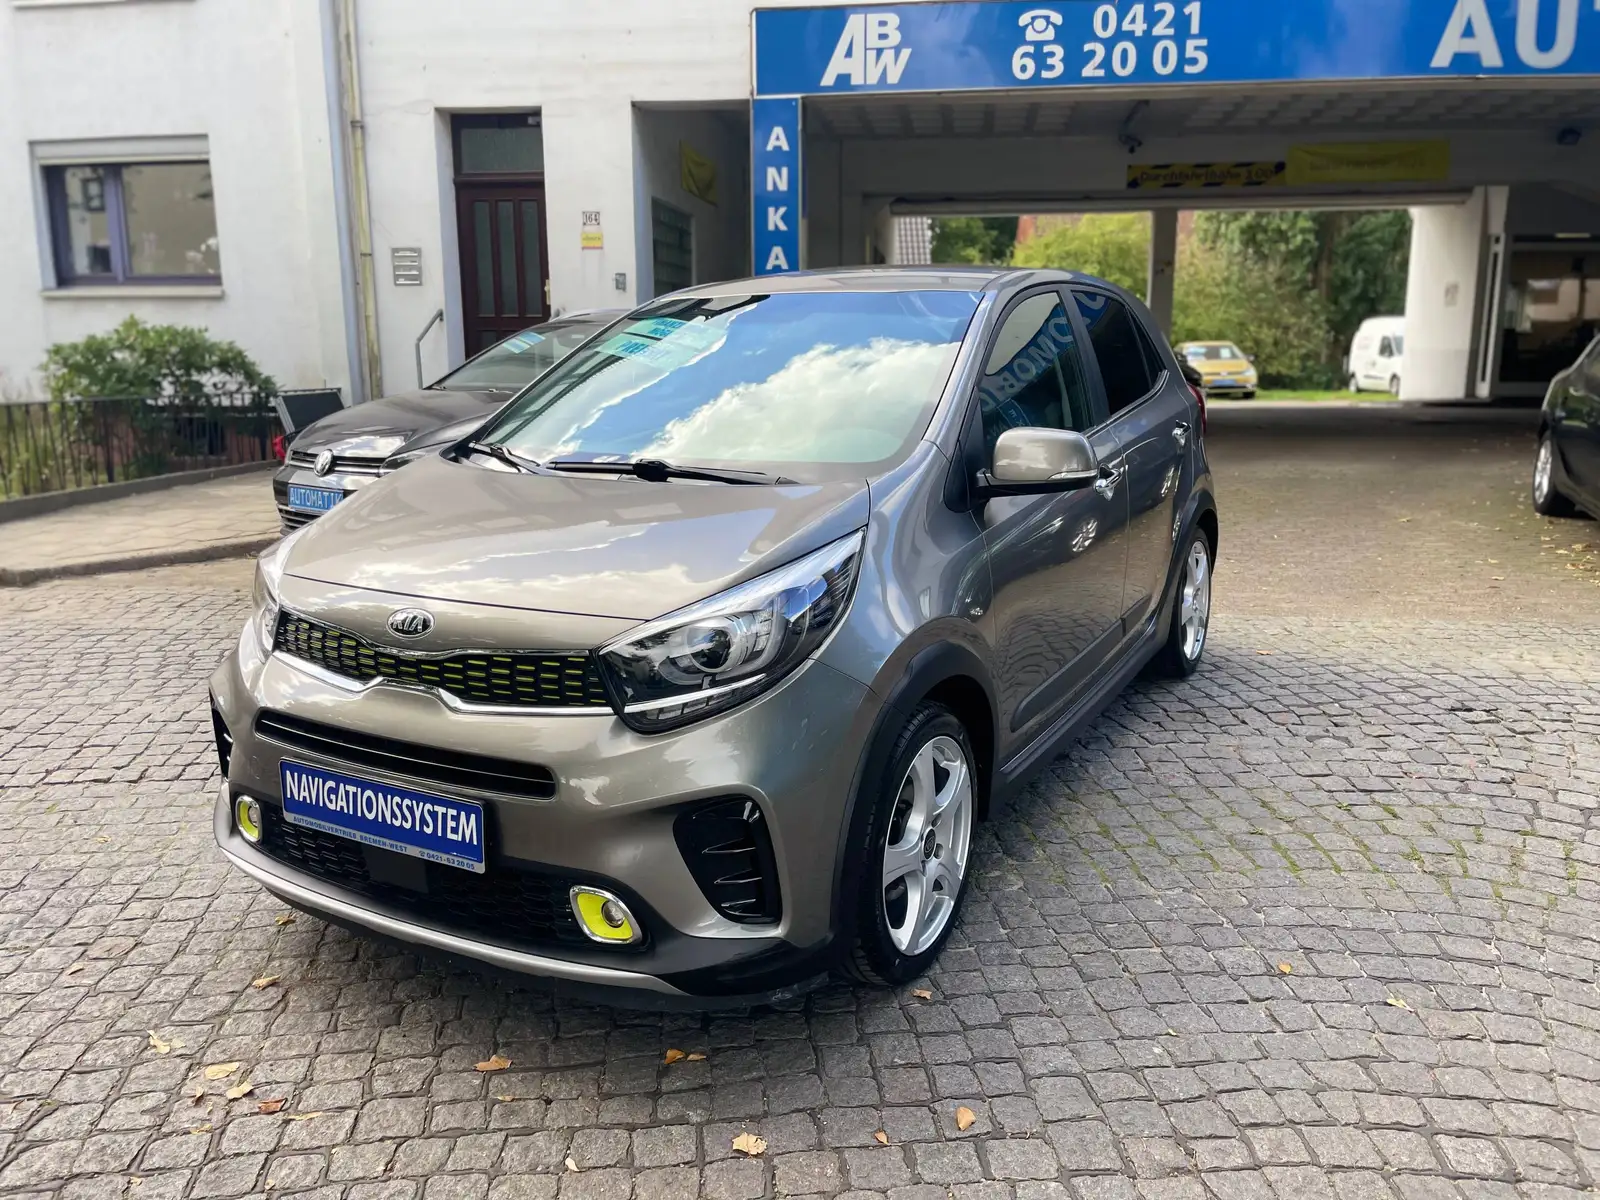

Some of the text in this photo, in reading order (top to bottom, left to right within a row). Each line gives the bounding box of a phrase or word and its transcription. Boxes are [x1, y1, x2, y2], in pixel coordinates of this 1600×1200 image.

[1093, 1, 1201, 39] 0421
[1429, 0, 1600, 69] AU
[1011, 38, 1209, 80] 63 20 05
[765, 126, 790, 270] ANKA
[285, 769, 478, 846] NAVIGATIONSSYSTEM
[359, 834, 408, 853] BREMEN-WEST
